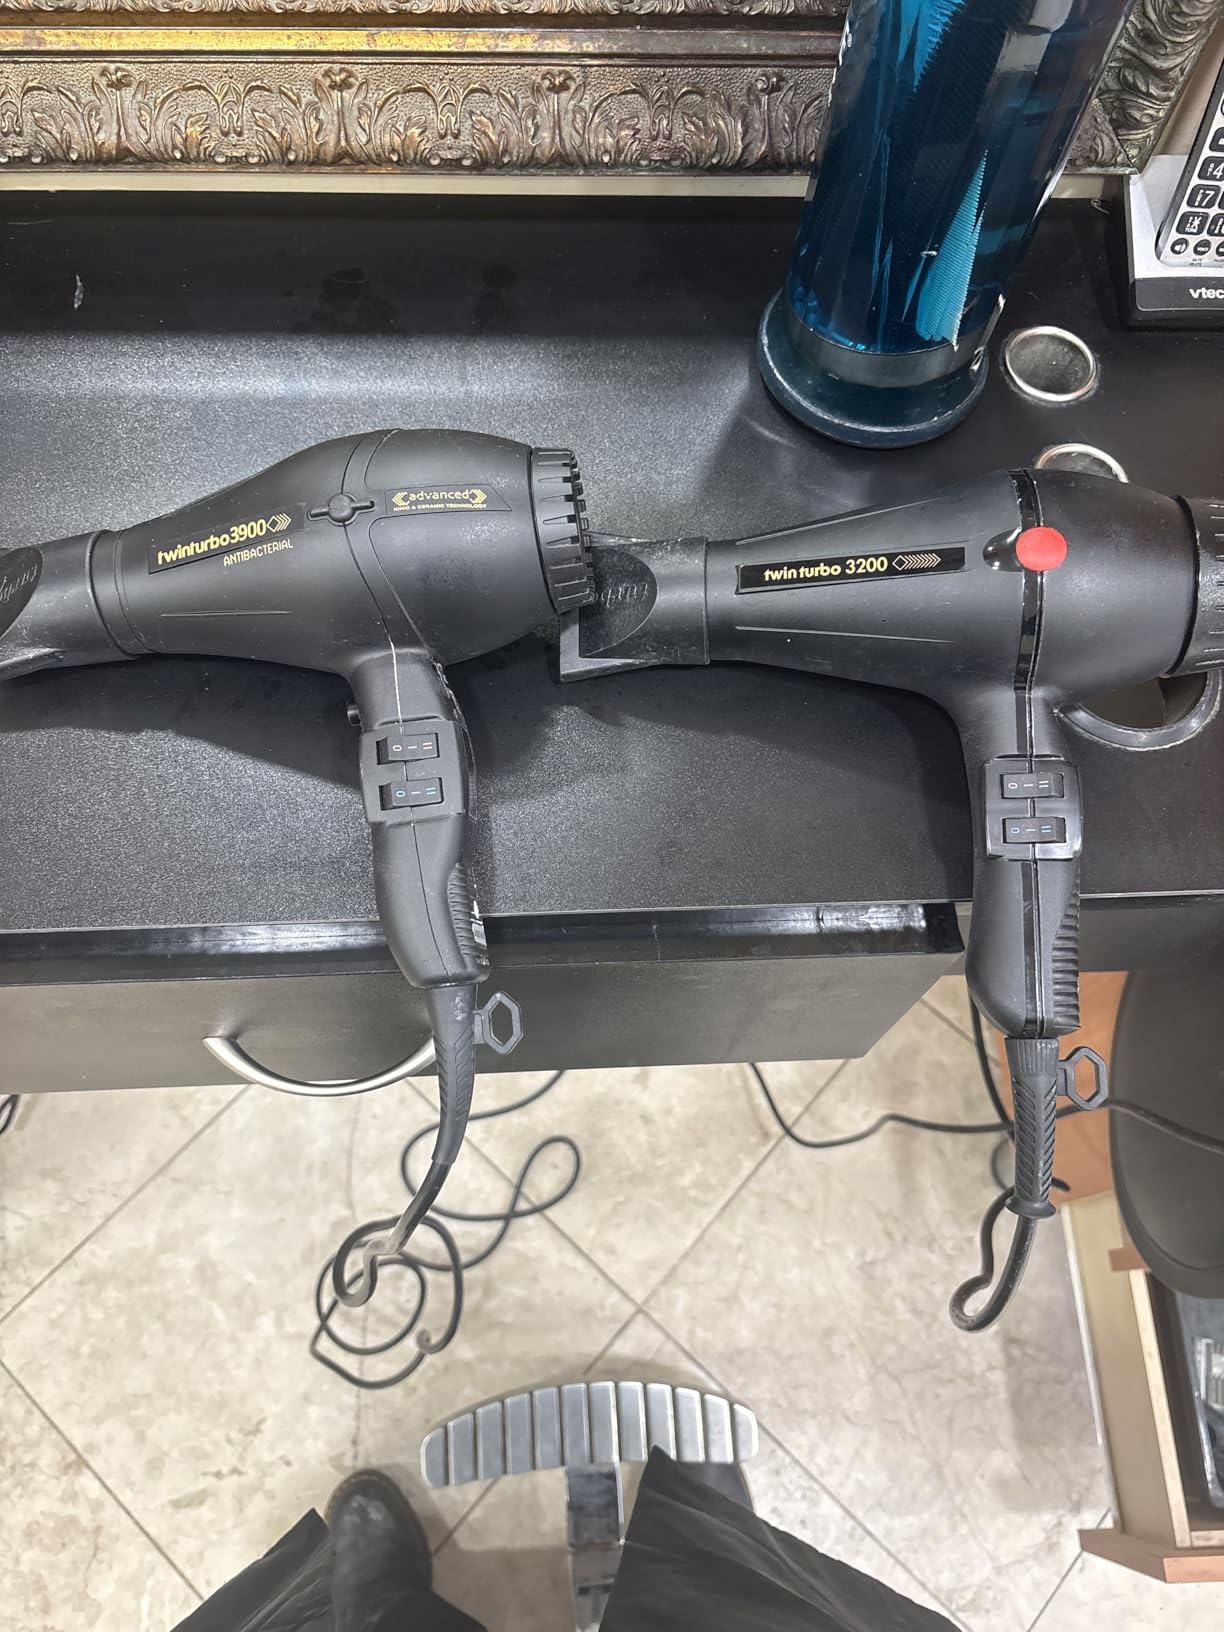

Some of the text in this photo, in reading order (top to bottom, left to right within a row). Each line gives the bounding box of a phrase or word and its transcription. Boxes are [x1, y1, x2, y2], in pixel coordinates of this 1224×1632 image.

[1201, 190, 1215, 206] 7
[409, 489, 470, 501] advanced
[223, 538, 294, 567] ANTIBACTERIAL
[763, 556, 888, 581] twin turbo 3200
